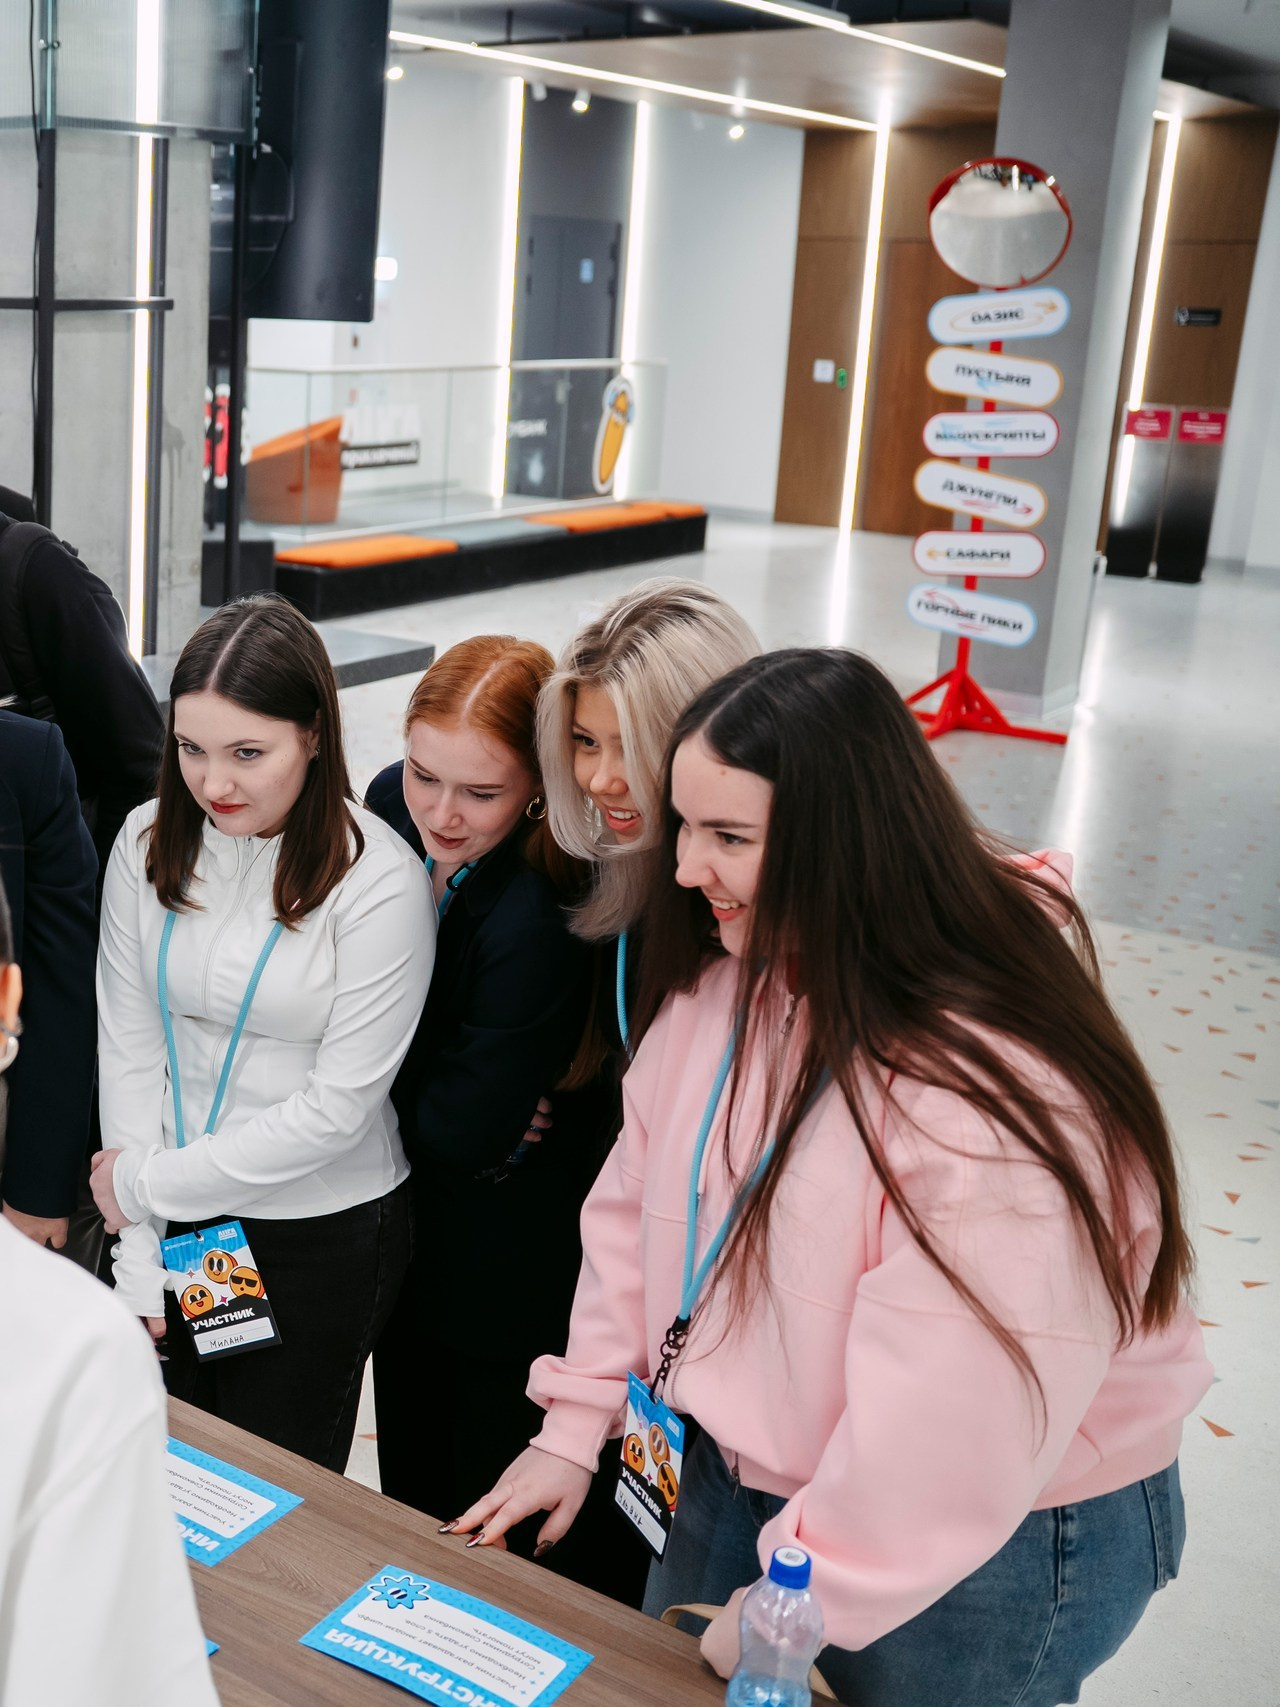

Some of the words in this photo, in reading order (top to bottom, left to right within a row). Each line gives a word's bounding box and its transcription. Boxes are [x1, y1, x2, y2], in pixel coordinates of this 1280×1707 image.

[955, 364, 1032, 387] ПУСТЫНЯ
[946, 548, 1010, 561] САФАРИ
[191, 1307, 255, 1331] УЧАСТНИК
[621, 1466, 662, 1520] УЧАСТНИК
[423, 1614, 481, 1642] Совкомбанка
[435, 1631, 469, 1650] угадать
[323, 1628, 500, 1707] НСТРУКЦИЯ
[469, 1648, 526, 1680] Необходимо
[482, 1641, 536, 1671] Сотрудники
[515, 1649, 541, 1664] могут
[476, 1665, 516, 1690] Участник
